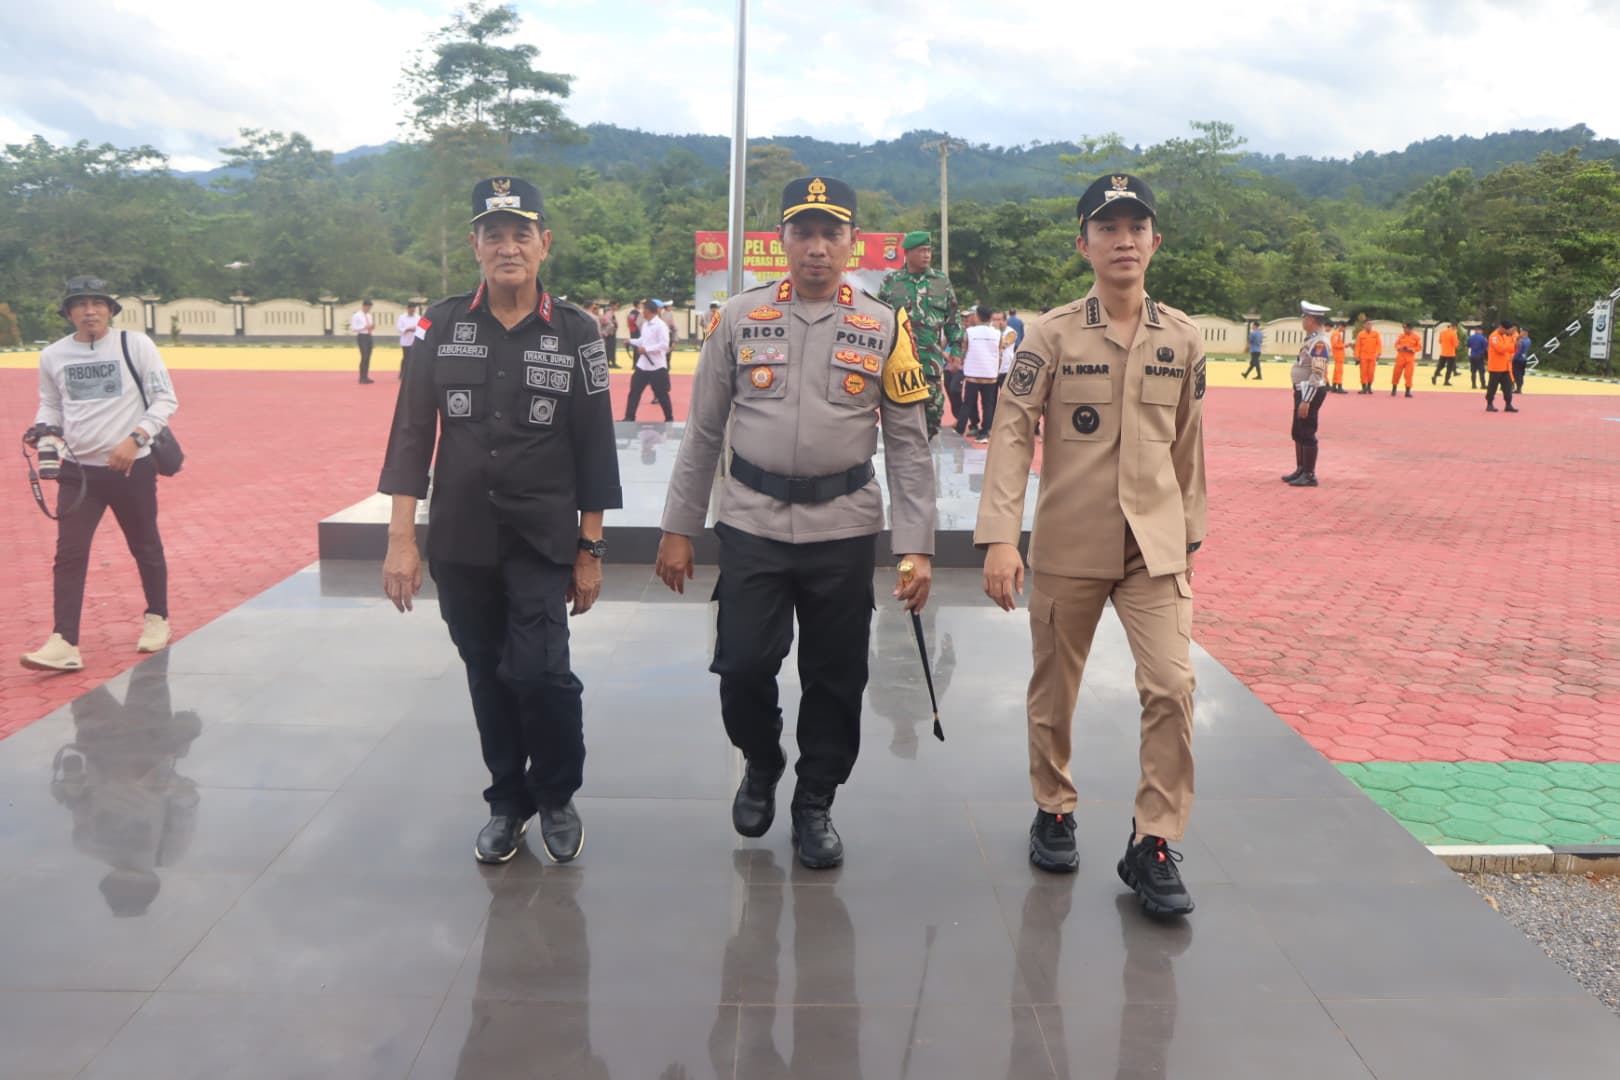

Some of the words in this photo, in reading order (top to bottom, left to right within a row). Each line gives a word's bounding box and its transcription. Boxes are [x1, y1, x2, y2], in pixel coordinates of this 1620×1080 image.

[744, 239, 766, 255] PEL
[743, 256, 773, 267] PERASI
[742, 326, 785, 339] RICO
[836, 331, 884, 350] POLRI
[441, 345, 484, 355] ABUHAERA
[526, 351, 548, 363] WAKIL
[550, 354, 573, 366] BUPATI
[1062, 365, 1075, 375] H.
[1145, 365, 1185, 379] BUPATI
